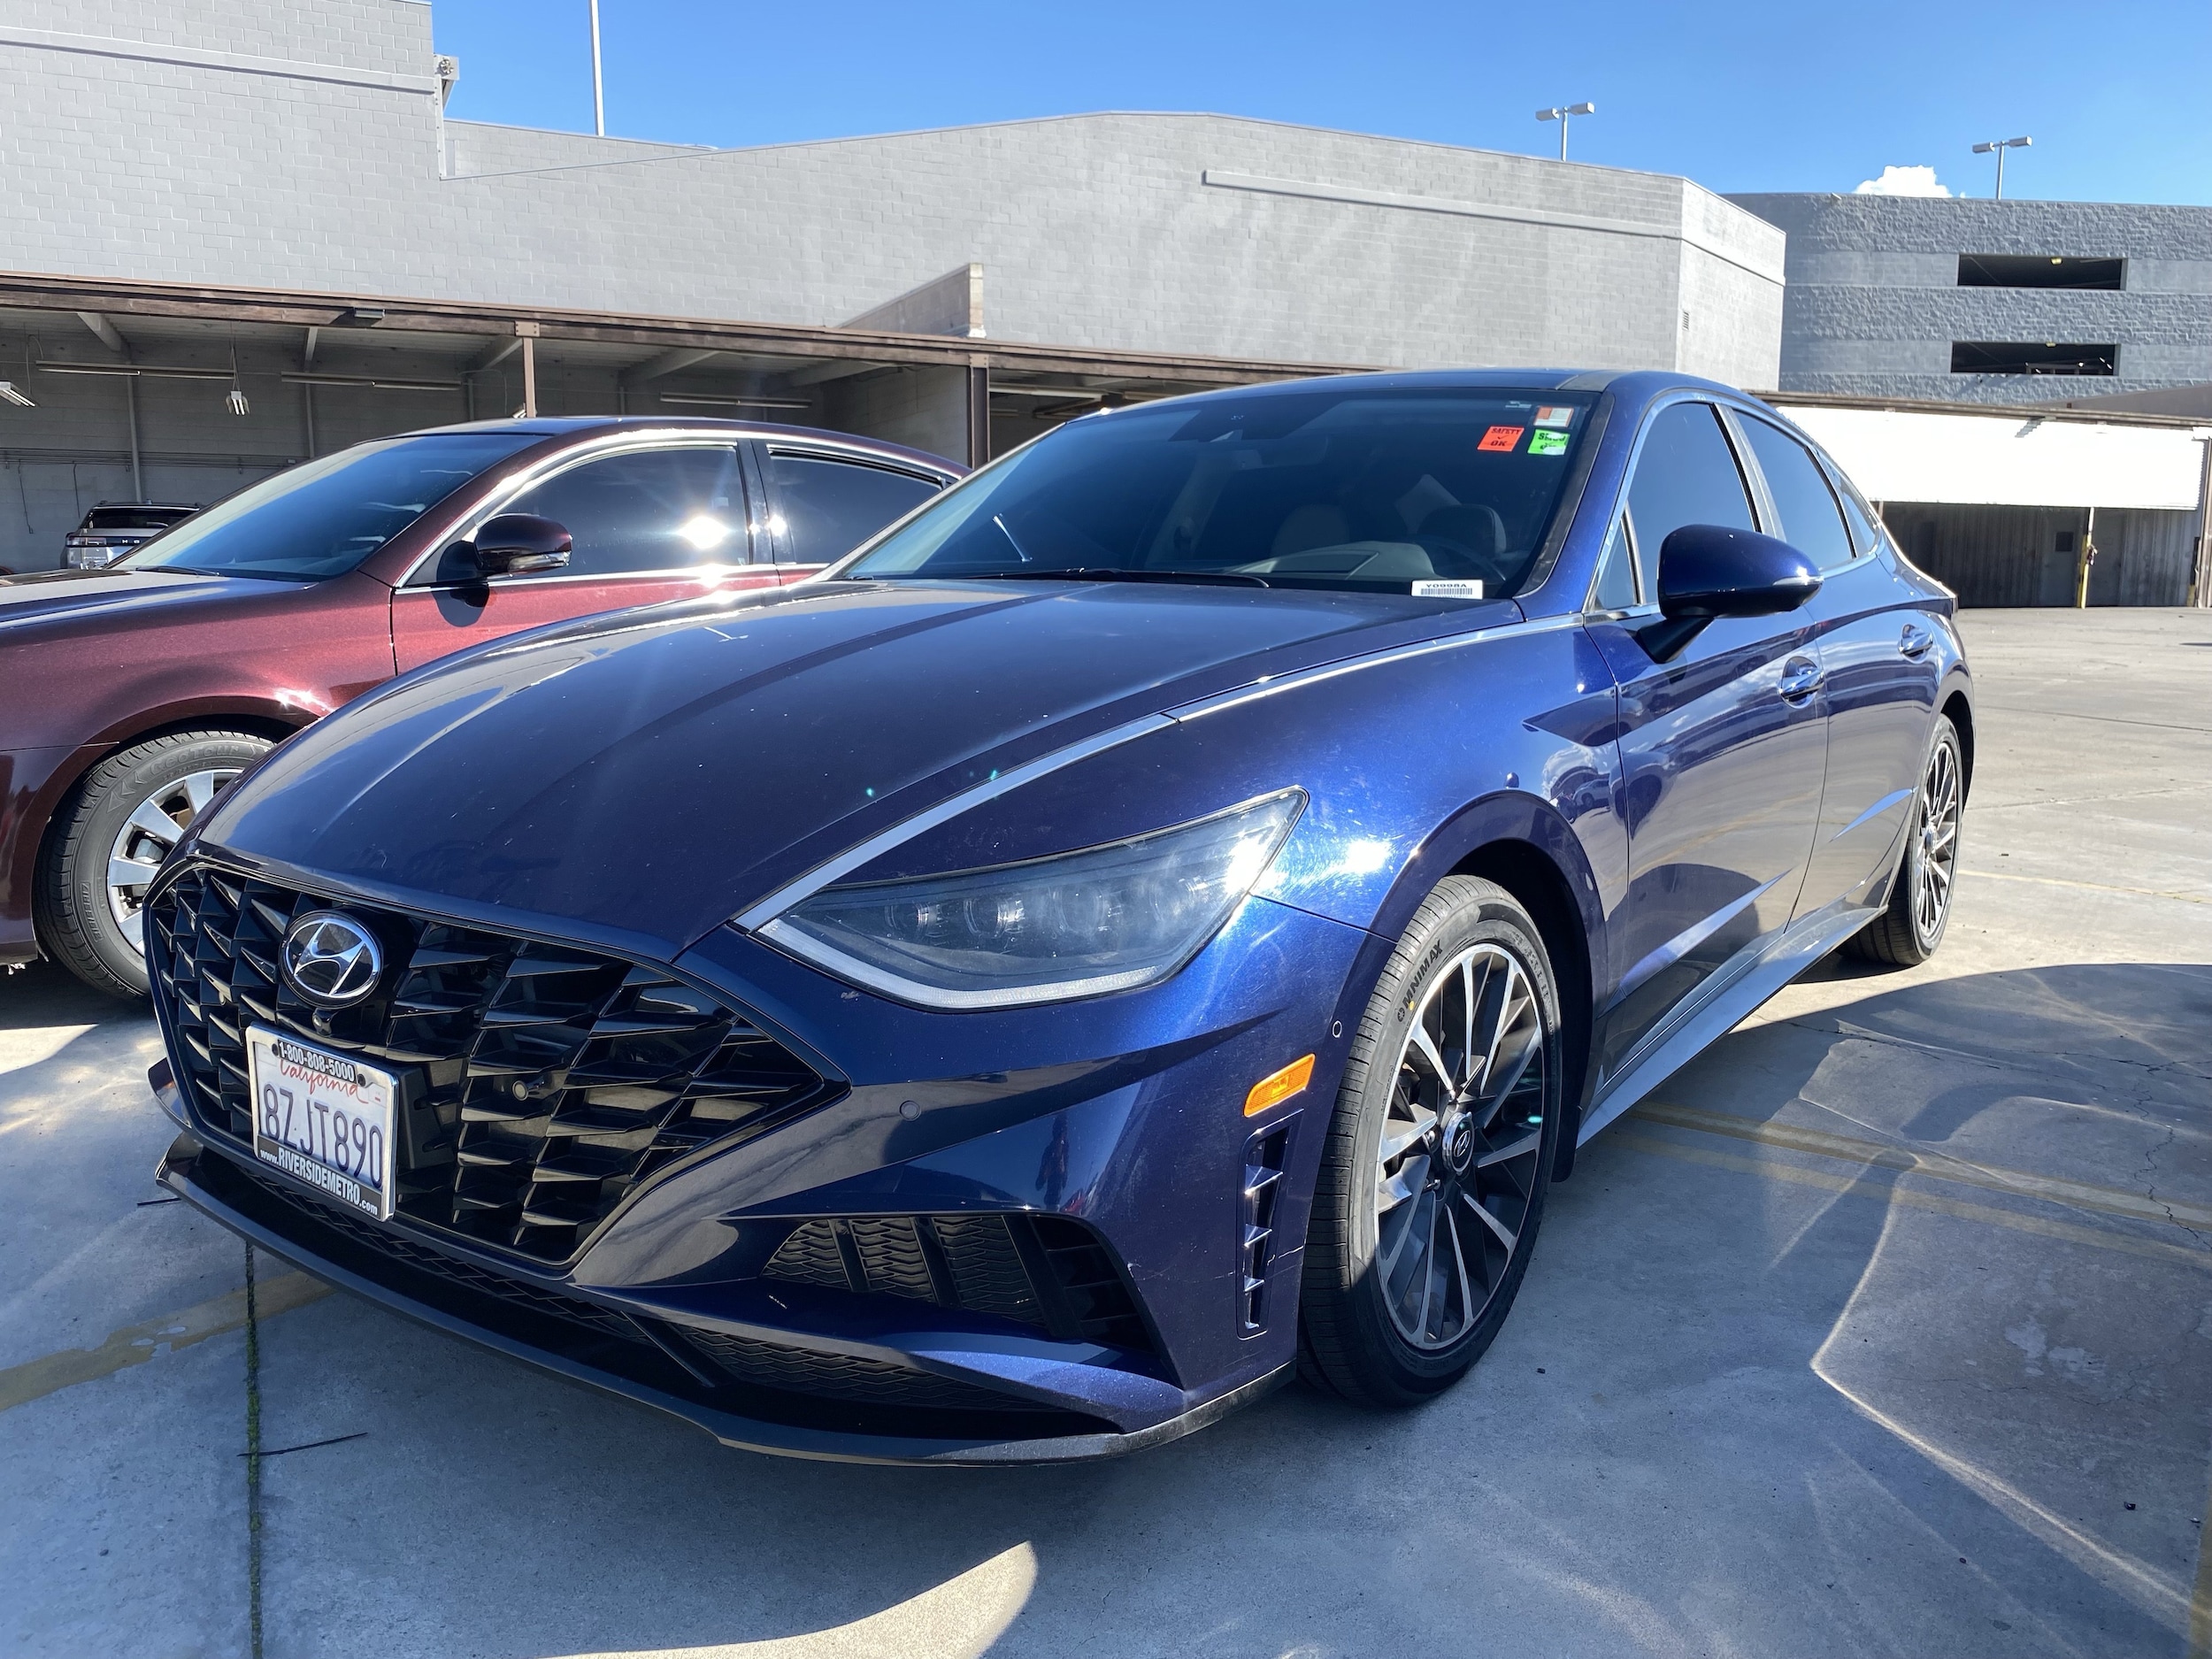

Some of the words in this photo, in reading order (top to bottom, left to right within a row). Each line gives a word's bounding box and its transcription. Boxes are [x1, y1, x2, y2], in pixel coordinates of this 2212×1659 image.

[279, 1041, 355, 1081] 1-800-808-5000
[279, 1059, 369, 1104] California
[264, 1083, 383, 1189] 8ZJT890
[260, 1147, 378, 1216] www.RIVERSIDEMETRO.com
